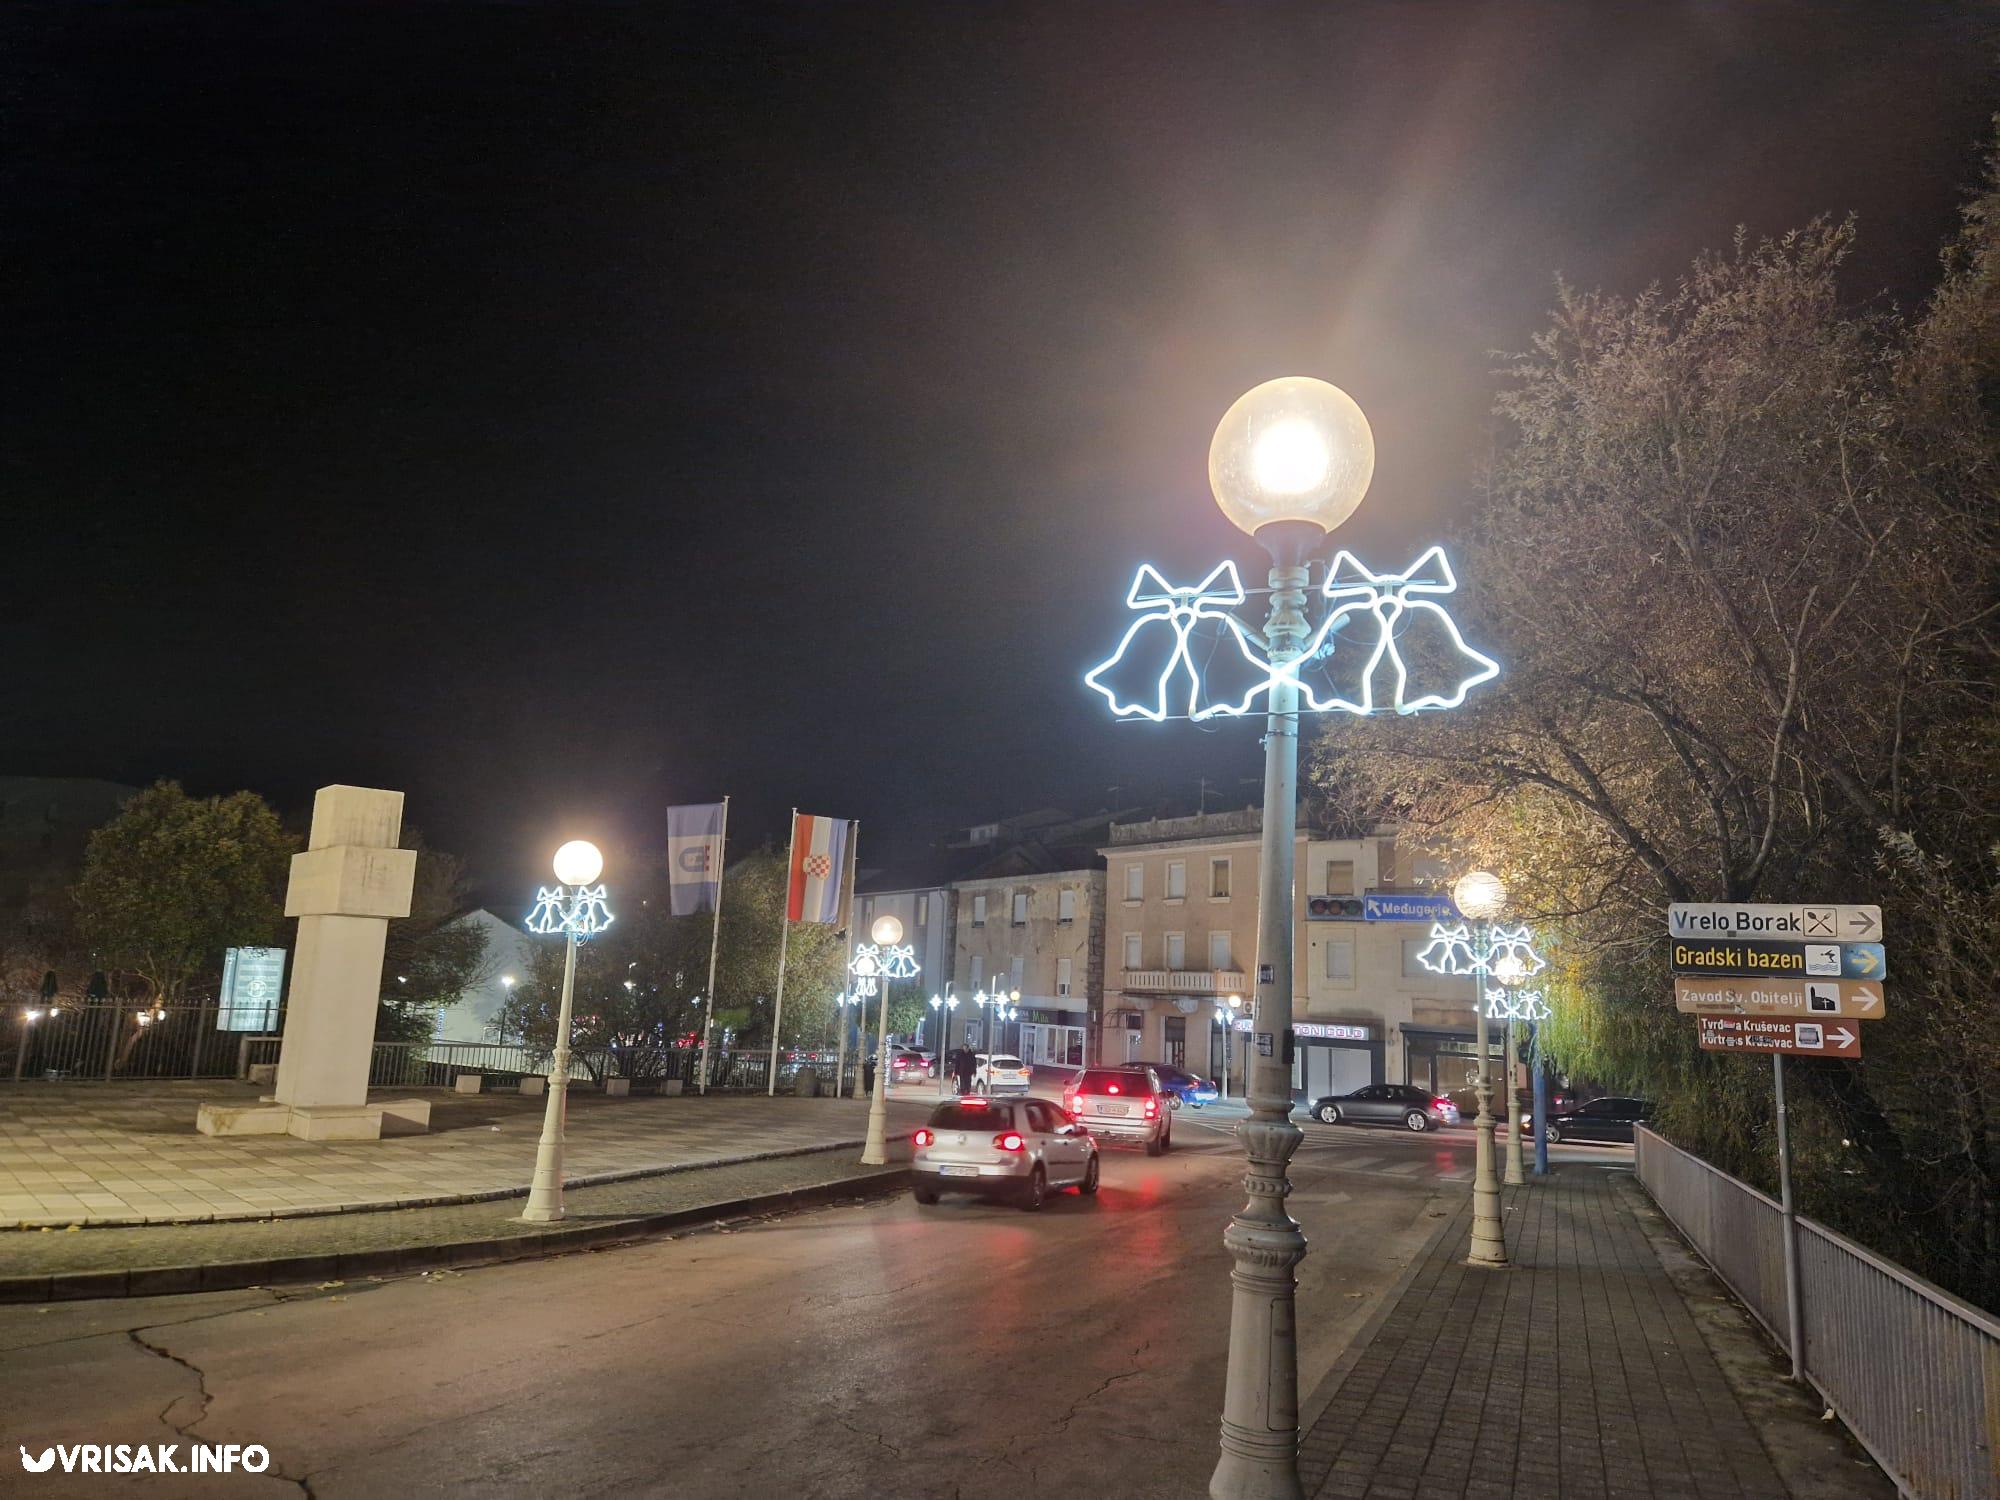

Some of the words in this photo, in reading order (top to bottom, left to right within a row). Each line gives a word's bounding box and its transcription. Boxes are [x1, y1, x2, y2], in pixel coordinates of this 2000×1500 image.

[1674, 911, 1730, 930] Vrelo
[1736, 911, 1801, 931] Borak
[1675, 945, 1741, 967] Gradski
[1747, 948, 1803, 969] bazen
[1680, 989, 1723, 1002] Zavod
[1751, 991, 1803, 1008] Obitelji
[1743, 1020, 1791, 1033] Kruševac
